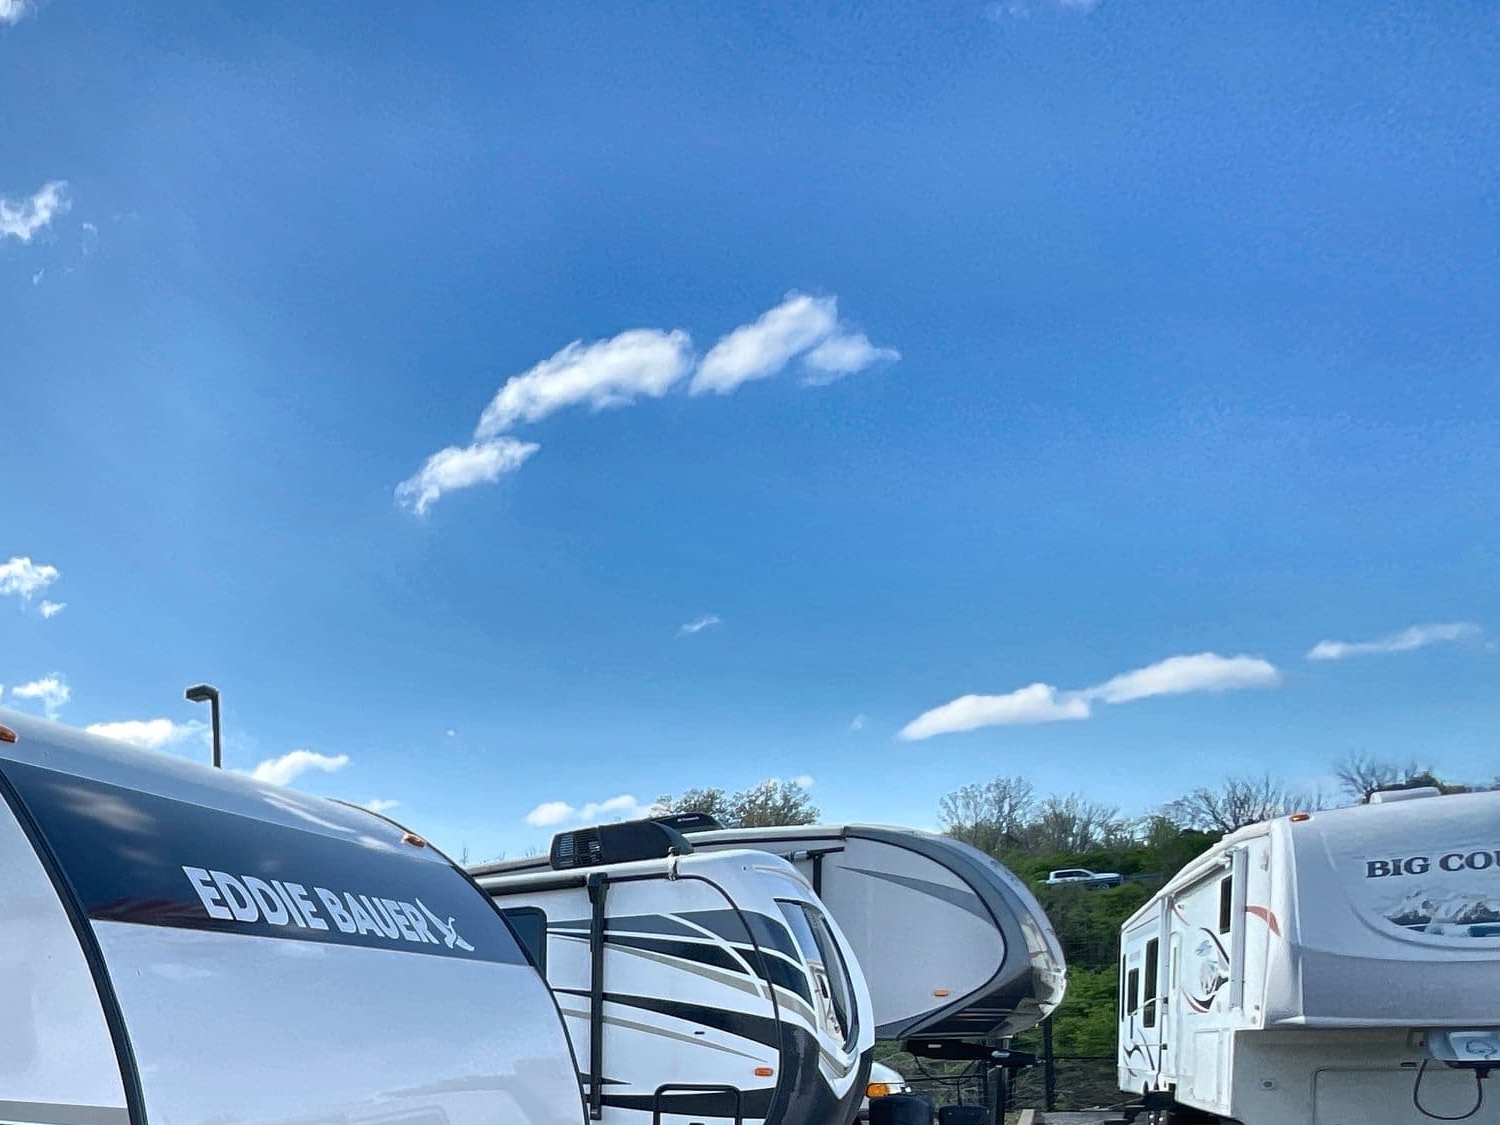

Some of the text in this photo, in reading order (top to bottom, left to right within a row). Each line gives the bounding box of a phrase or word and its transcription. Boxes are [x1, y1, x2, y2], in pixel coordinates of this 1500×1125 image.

[1366, 851, 1500, 878] BIG CO
[181, 865, 440, 945] EDDIE BAUER
